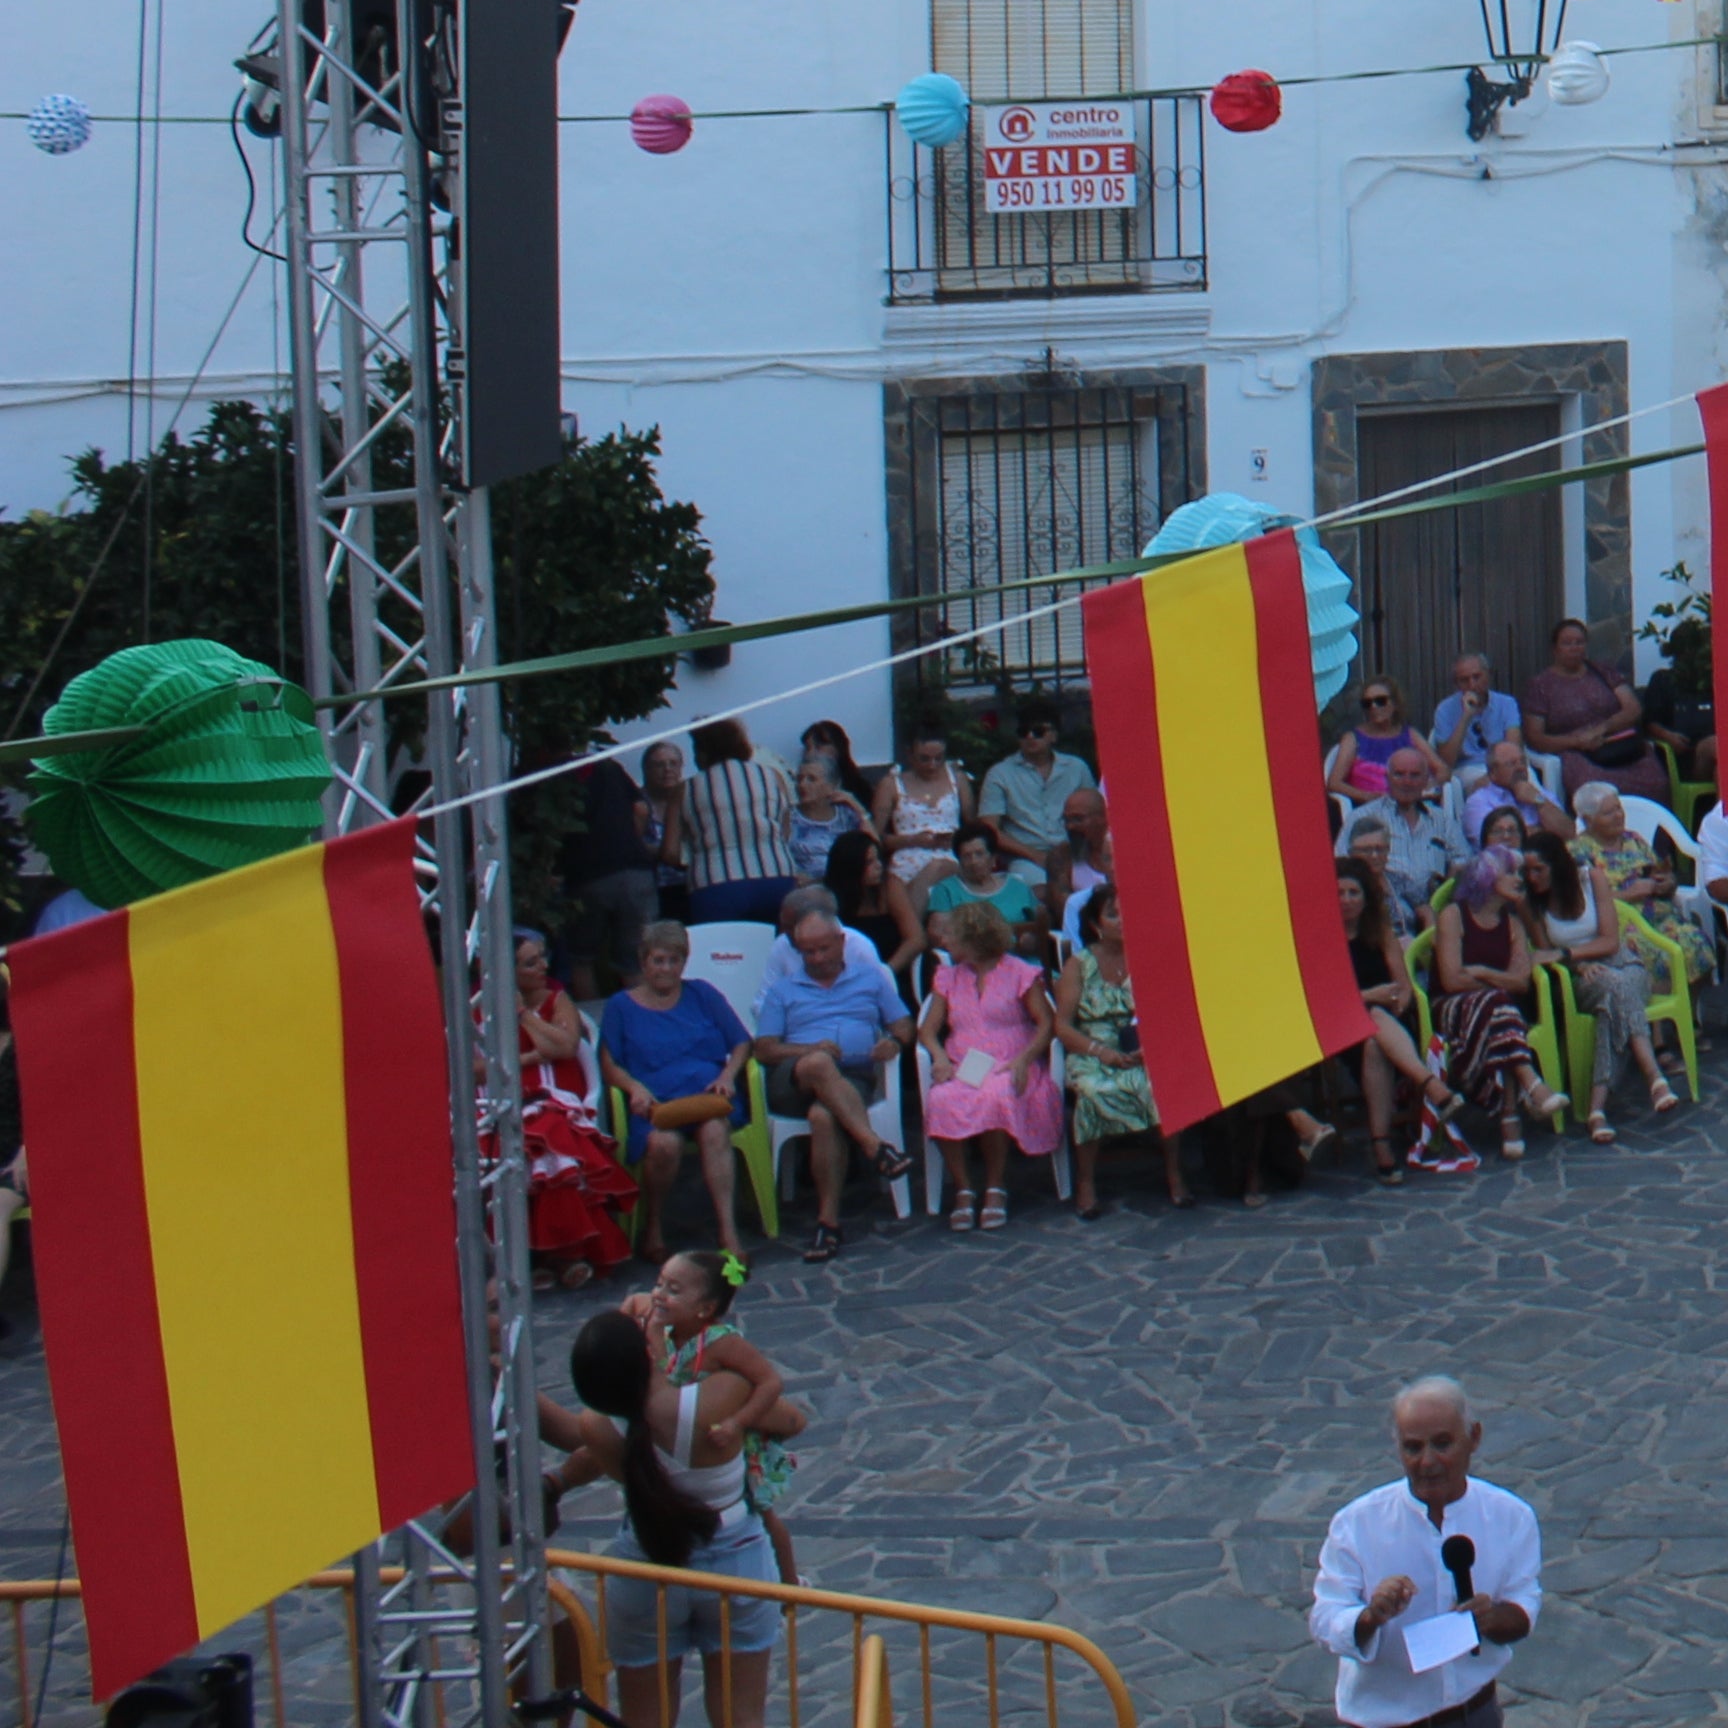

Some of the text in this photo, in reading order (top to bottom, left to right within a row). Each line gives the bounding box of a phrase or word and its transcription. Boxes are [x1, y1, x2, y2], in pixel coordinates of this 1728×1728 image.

[1050, 107, 1119, 123] centro
[989, 147, 1127, 175] VENDE
[997, 178, 1125, 206] 950 11 99 05
[1254, 455, 1265, 473] 9
